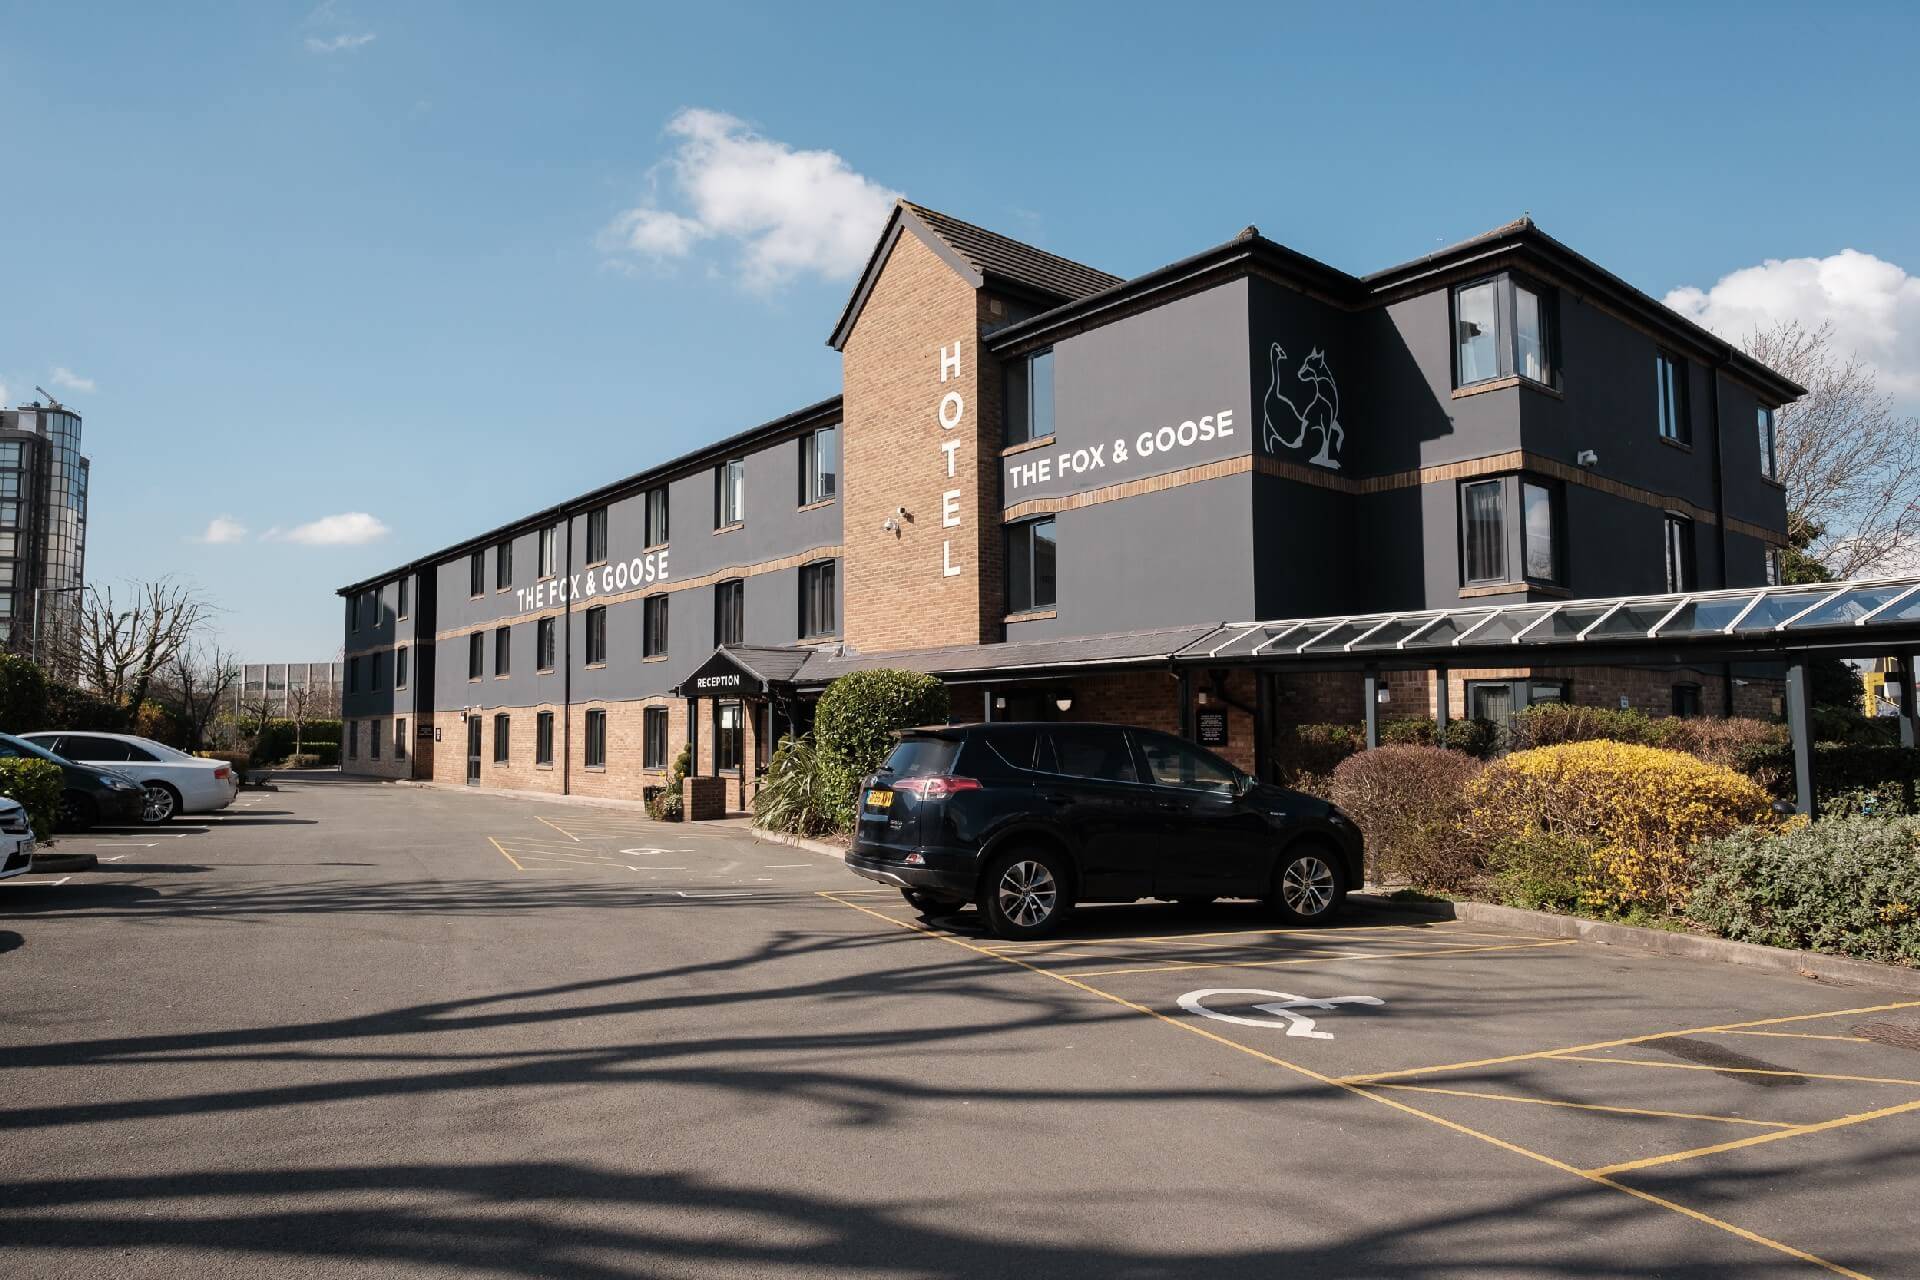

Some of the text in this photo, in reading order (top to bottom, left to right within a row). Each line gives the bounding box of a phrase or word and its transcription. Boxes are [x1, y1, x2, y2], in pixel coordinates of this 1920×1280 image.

[938, 340, 964, 578] HOTEL
[1009, 409, 1234, 489] THE FOX & GOOSE
[517, 584, 544, 612] THE
[585, 570, 596, 596] &
[602, 551, 669, 592] GOOSE
[697, 674, 740, 689] RECEPTION
